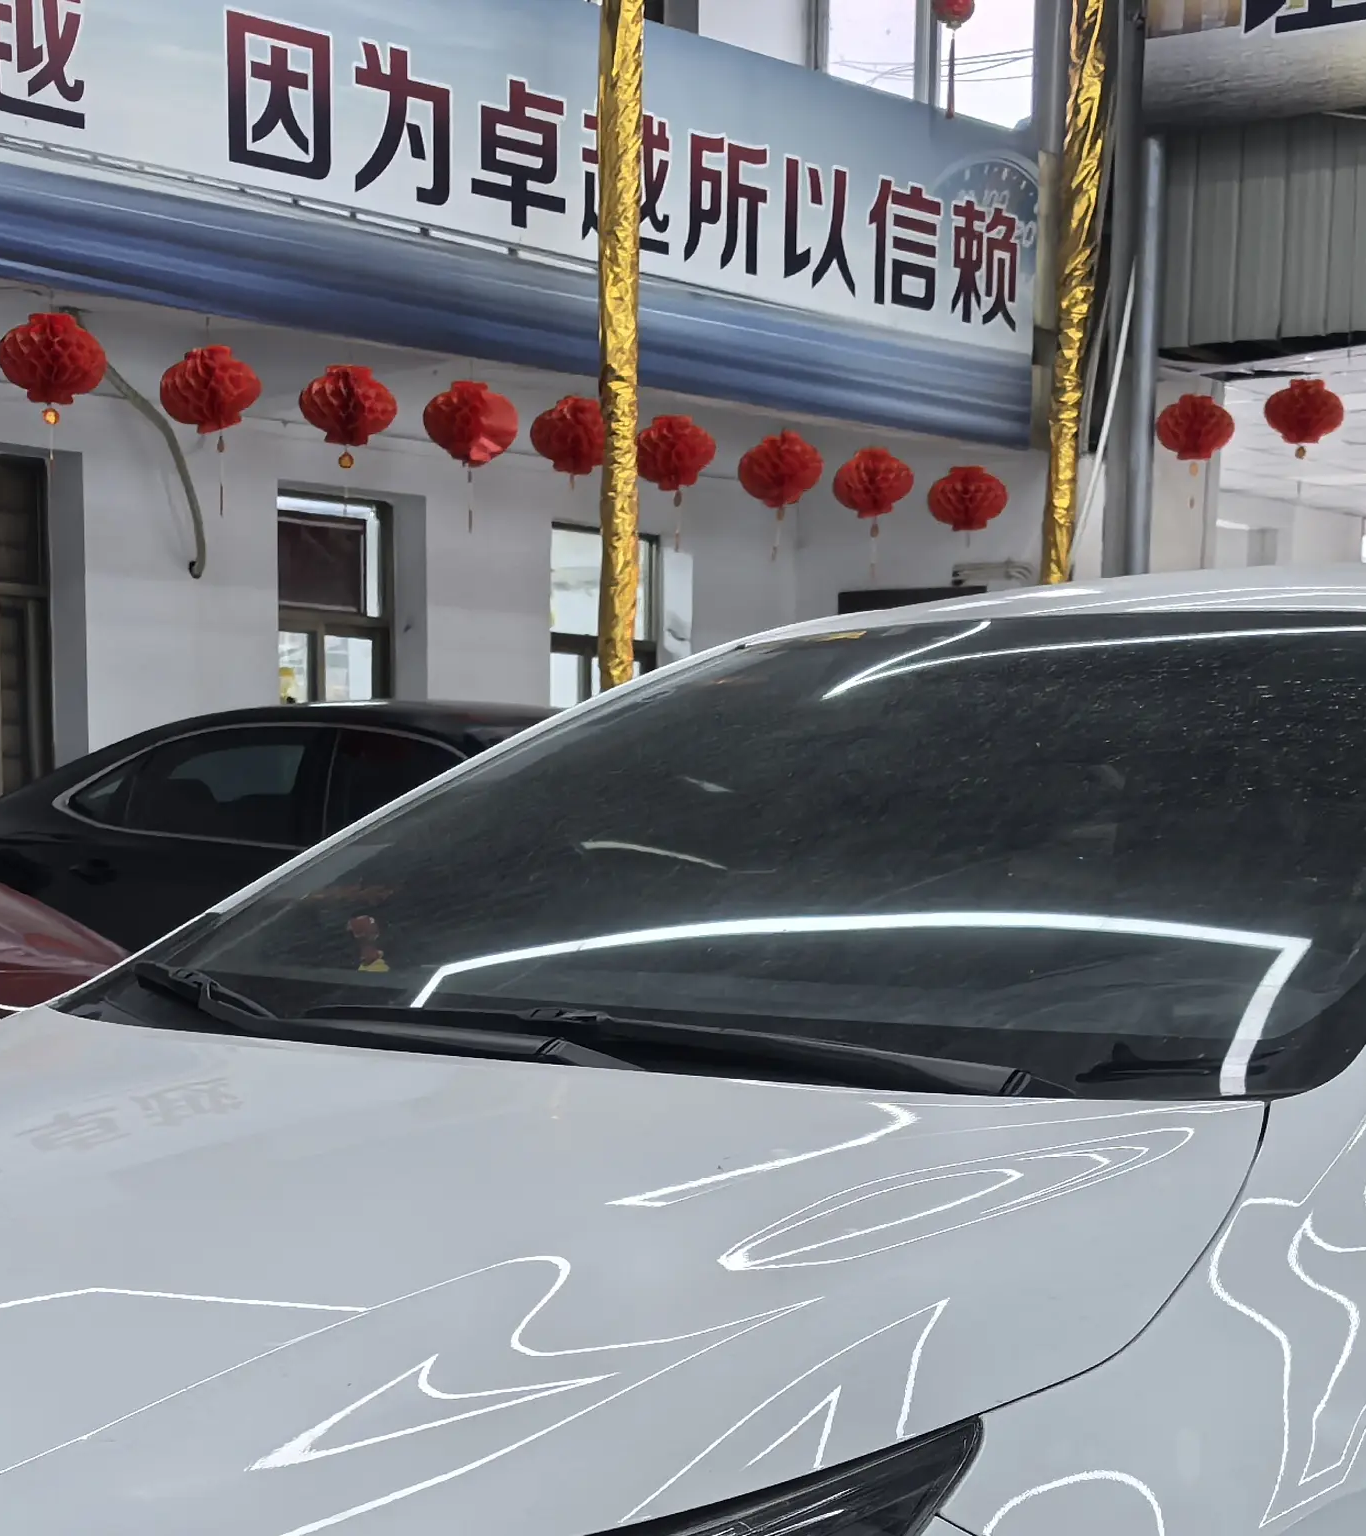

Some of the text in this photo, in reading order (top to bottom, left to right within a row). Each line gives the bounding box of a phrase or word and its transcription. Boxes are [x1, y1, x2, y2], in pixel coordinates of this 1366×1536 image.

[226, 8, 1019, 332] 因为卓越所以信赖
